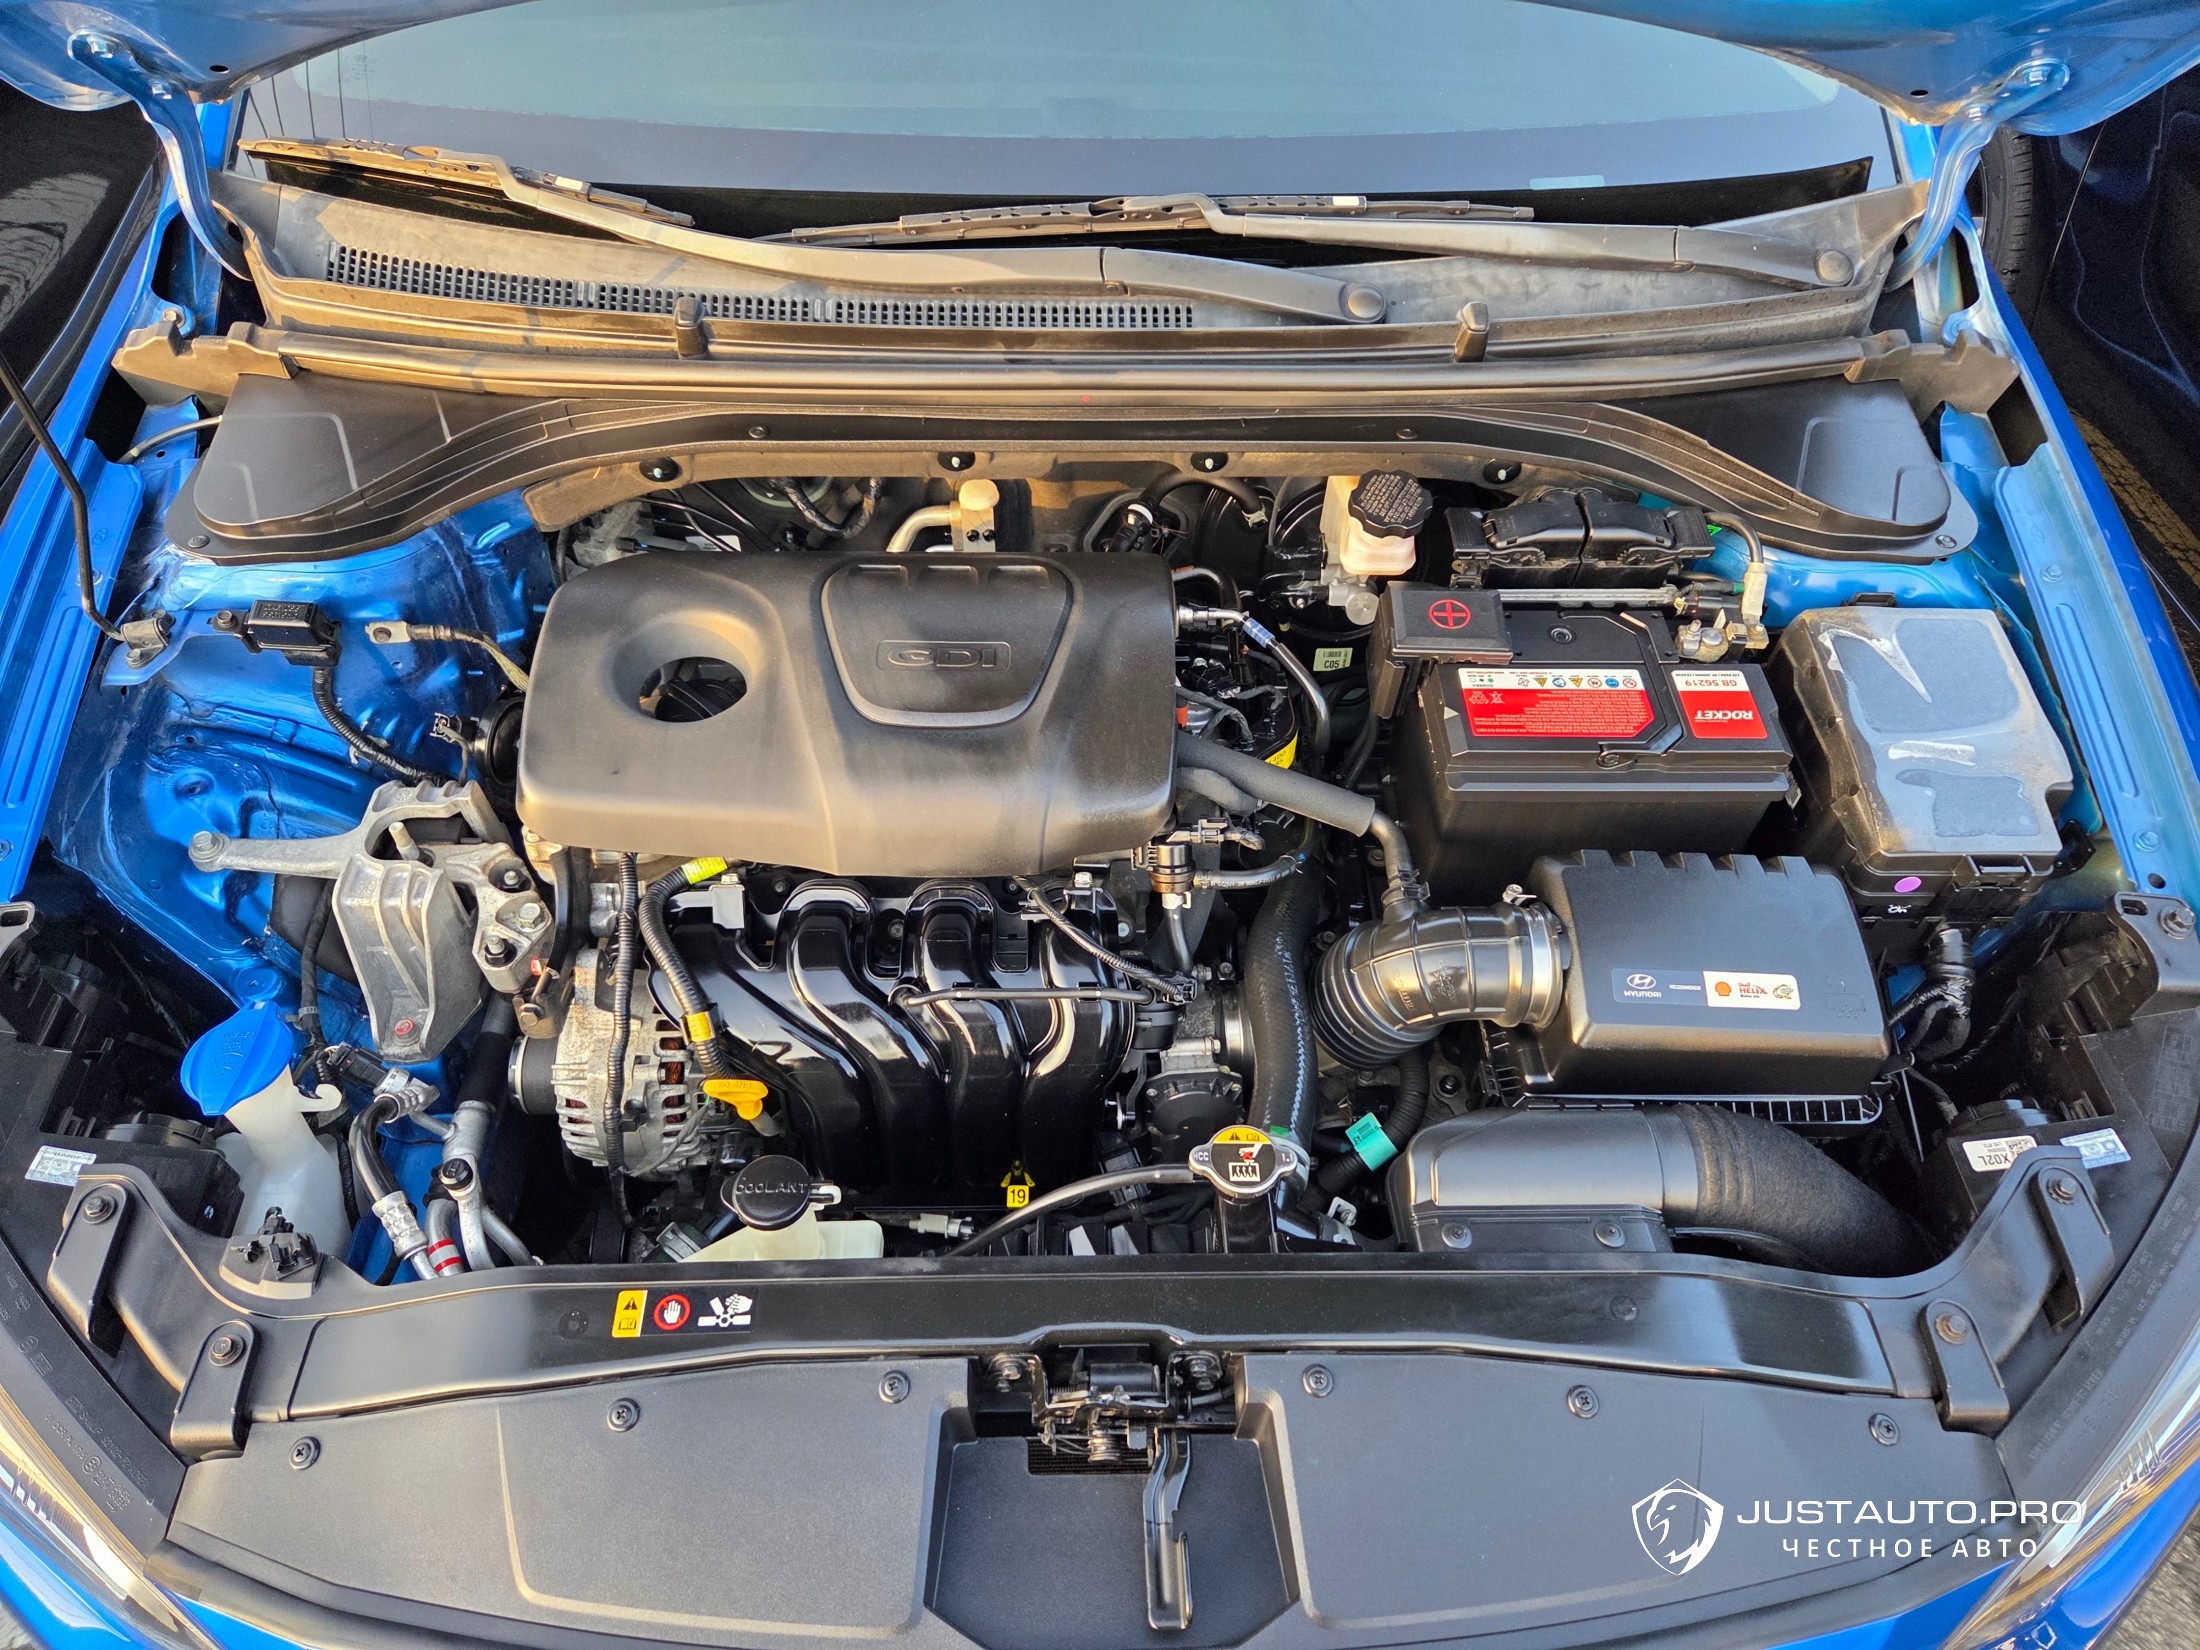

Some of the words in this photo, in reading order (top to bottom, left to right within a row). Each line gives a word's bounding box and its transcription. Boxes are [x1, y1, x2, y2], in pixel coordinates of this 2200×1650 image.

[888, 648, 996, 667] GDI
[1323, 660, 1340, 669] C05
[1685, 679, 1720, 687] 56219
[1721, 679, 1738, 687] GB
[1694, 710, 1754, 720] ROCKET
[1623, 990, 1662, 998] HYUNDAI
[1739, 987, 1768, 995] HELIX
[1977, 1153, 2011, 1166] X02L
[735, 1181, 809, 1195] COOLANT
[1010, 1189, 1026, 1204] 19
